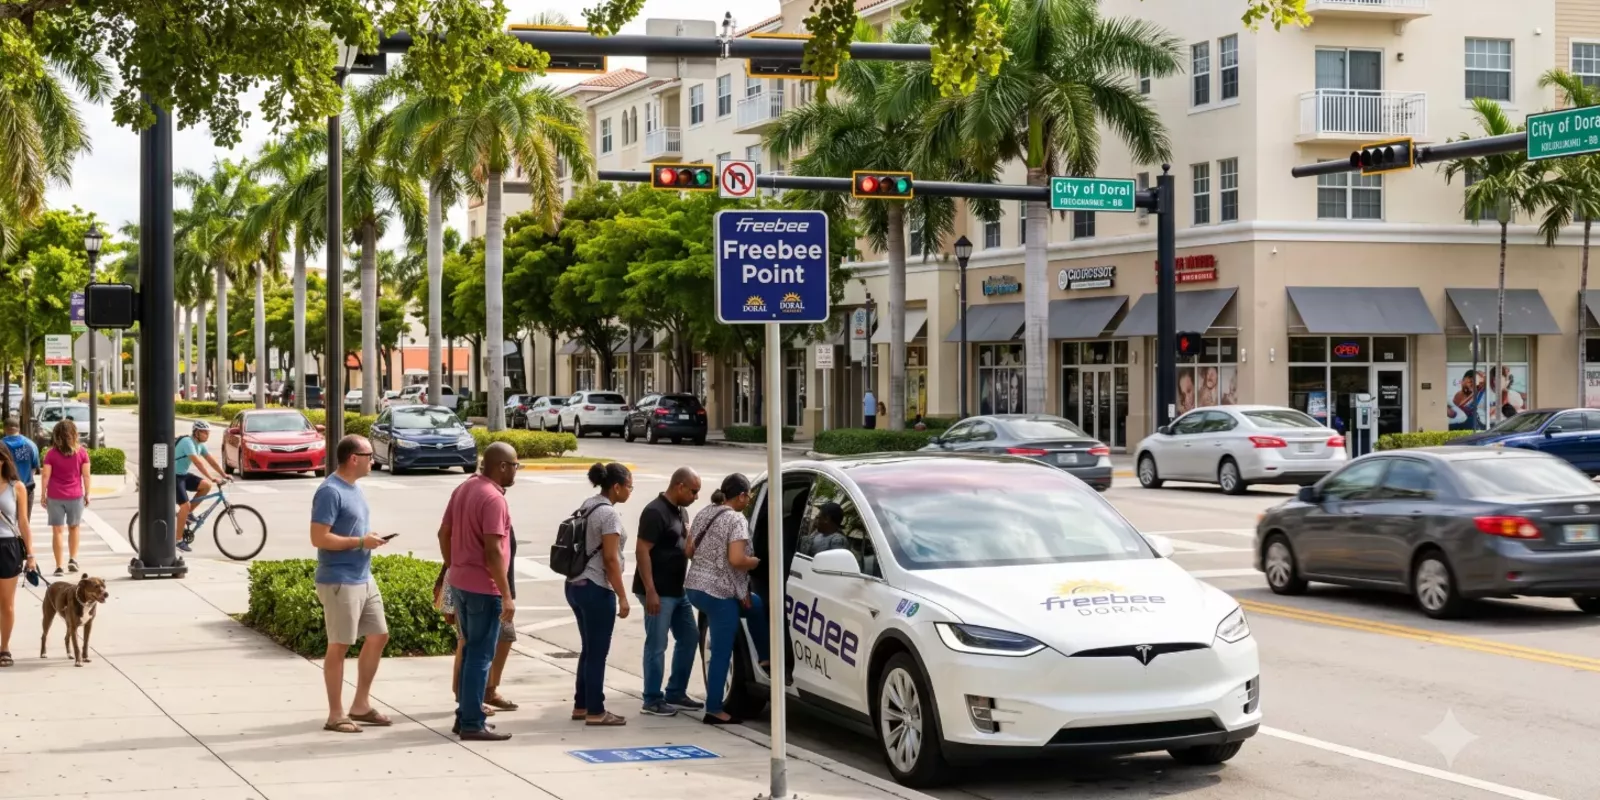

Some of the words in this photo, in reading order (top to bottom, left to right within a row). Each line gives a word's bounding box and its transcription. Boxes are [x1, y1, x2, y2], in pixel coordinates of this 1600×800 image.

[1532, 121, 1554, 139] City
[1558, 117, 1569, 133] of
[1574, 115, 1600, 131] Dora
[1055, 182, 1079, 197] City
[1083, 183, 1095, 194] of
[1099, 183, 1130, 196] Doral
[736, 217, 810, 233] freebee
[723, 239, 823, 260] Freebee
[742, 264, 804, 284] Point
[779, 302, 805, 310] DORAL
[1334, 345, 1360, 355] OPEN
[1040, 593, 1166, 611] freebee
[1077, 606, 1156, 616] DORAL
[785, 594, 859, 668] ebee
[794, 640, 832, 680] ORAL
